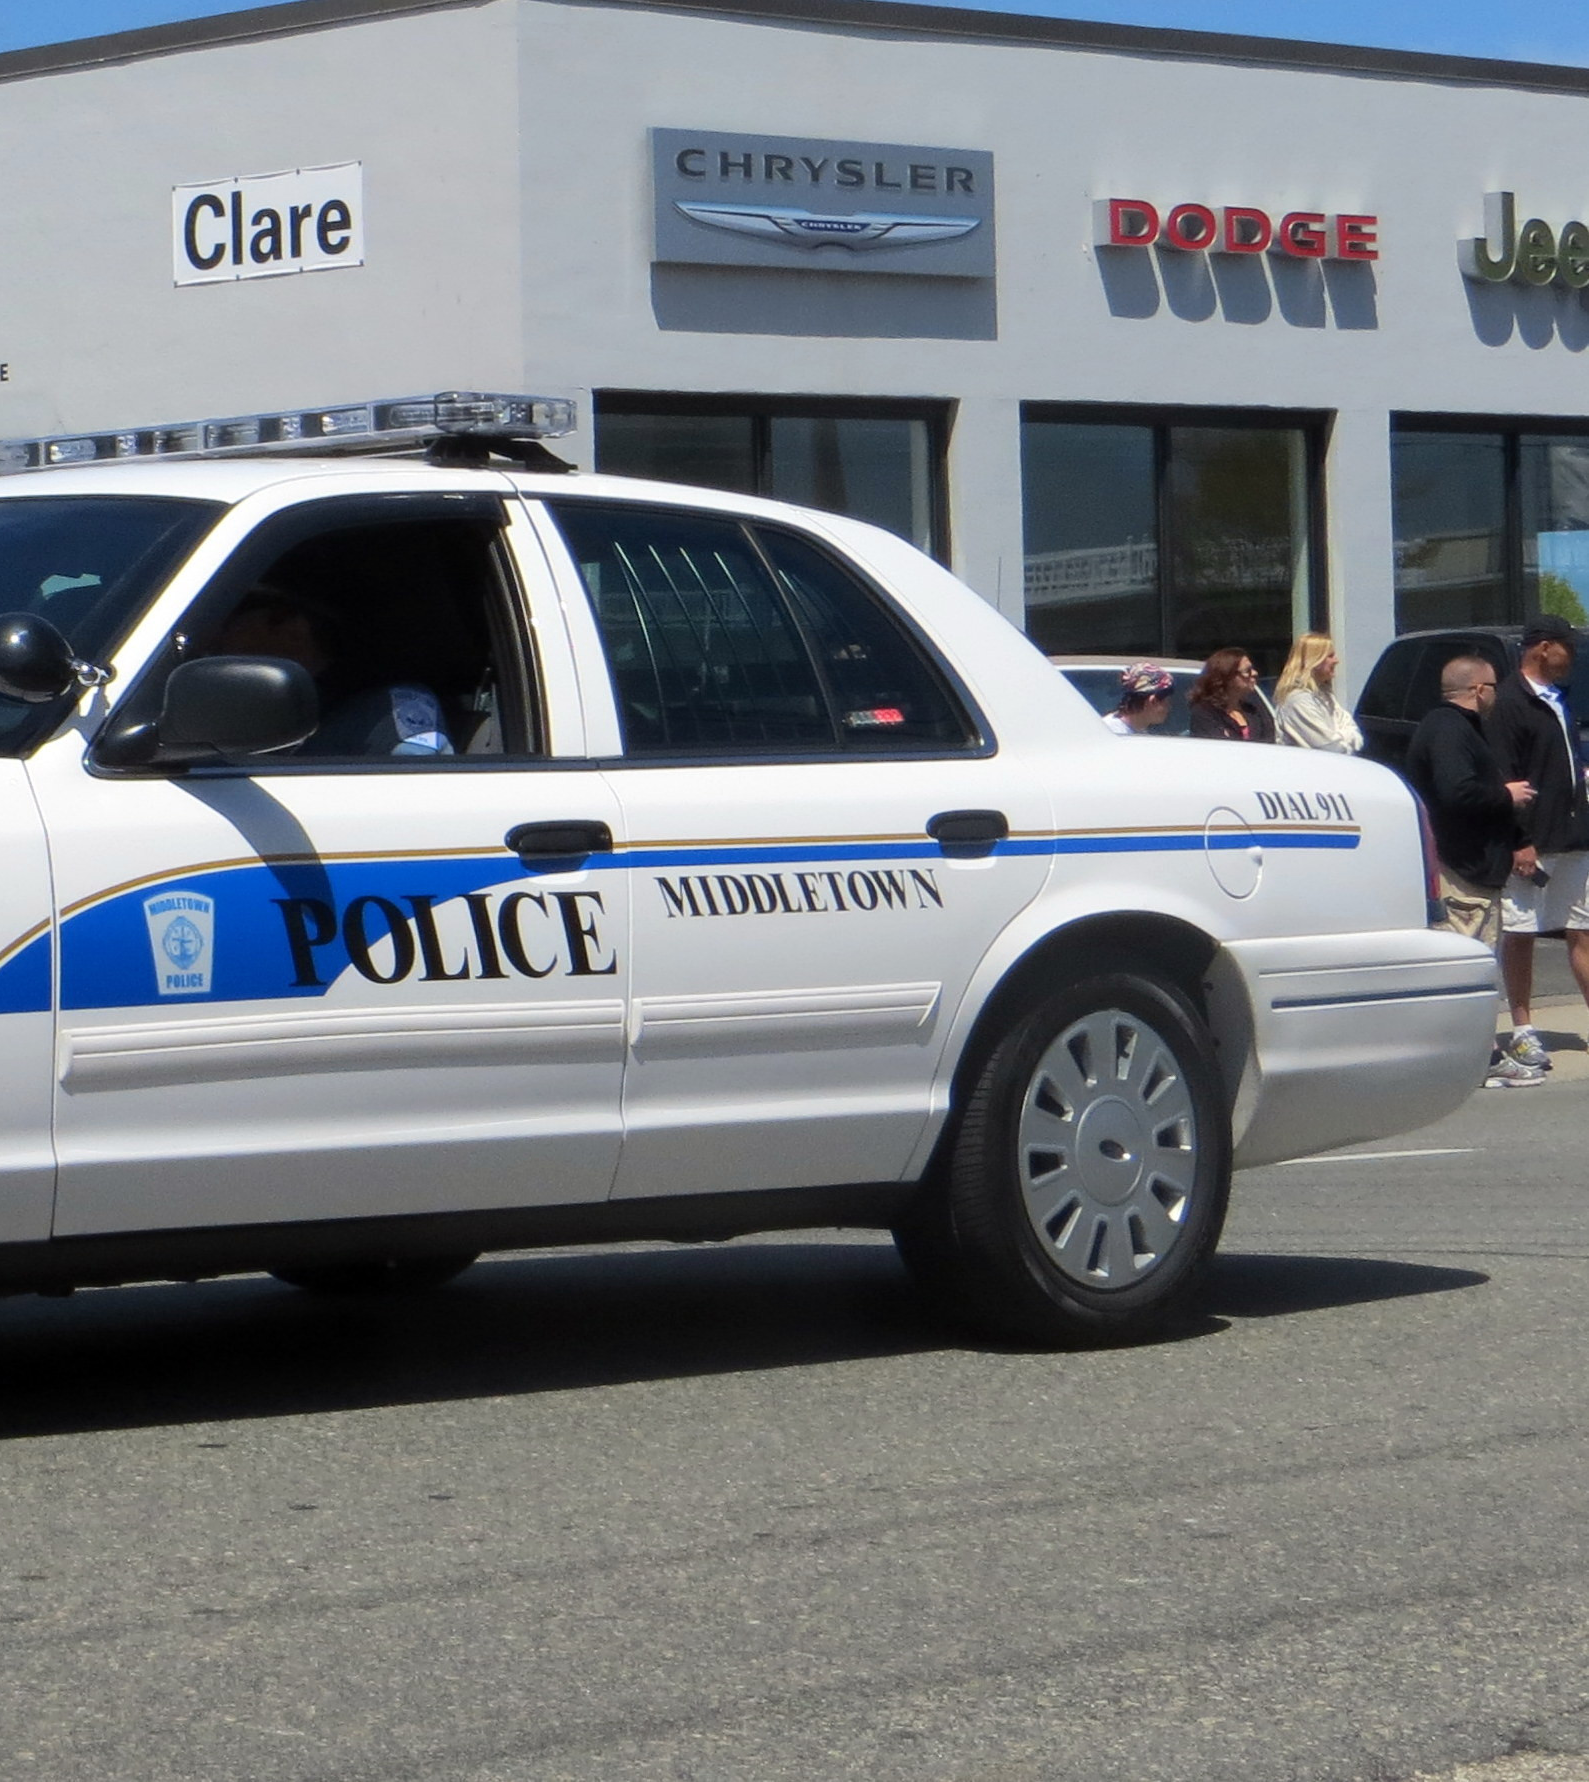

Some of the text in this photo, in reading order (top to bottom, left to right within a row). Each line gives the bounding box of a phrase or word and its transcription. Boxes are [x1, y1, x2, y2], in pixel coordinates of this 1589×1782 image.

[675, 148, 974, 193] CHRYSLER
[184, 190, 352, 270] Clare
[801, 222, 862, 230] CHRYSLER
[1109, 199, 1380, 261] DODGE
[1253, 791, 1355, 821] DIAL 911
[148, 897, 211, 916] MIDDLETOWN
[654, 868, 945, 919] MIDDLETOWN
[272, 889, 617, 988] POLICE
[166, 973, 204, 989] POLICE
